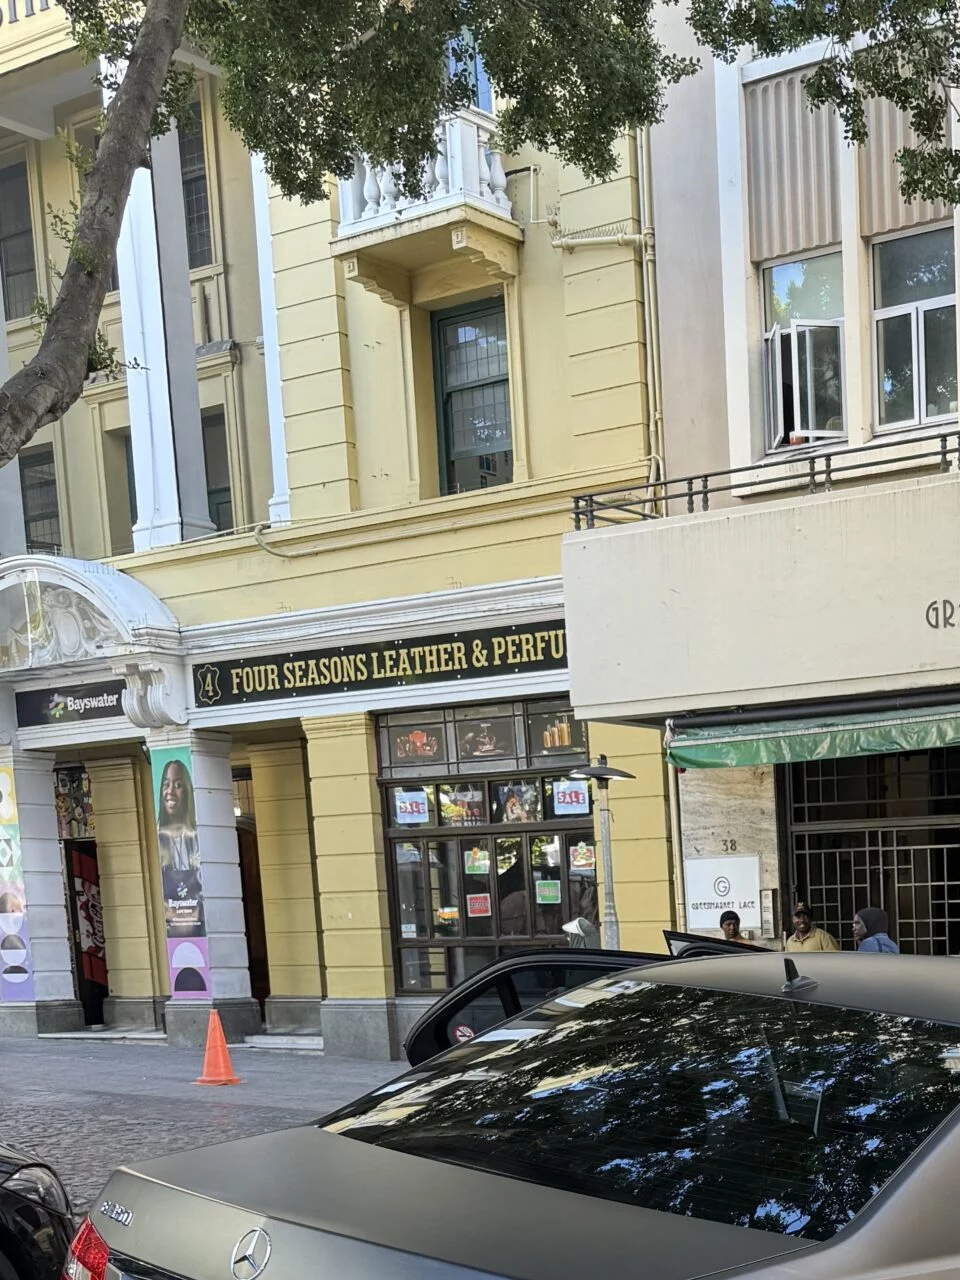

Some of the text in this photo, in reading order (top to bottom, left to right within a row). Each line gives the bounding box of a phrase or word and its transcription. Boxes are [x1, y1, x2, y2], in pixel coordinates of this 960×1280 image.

[231, 629, 566, 694] FOUR SEASONS LEATHER & PERFU
[204, 672, 214, 697] 4
[67, 693, 119, 714] Bayswater
[400, 800, 425, 814] SALE
[558, 792, 585, 805] SALE
[721, 839, 737, 852] 38
